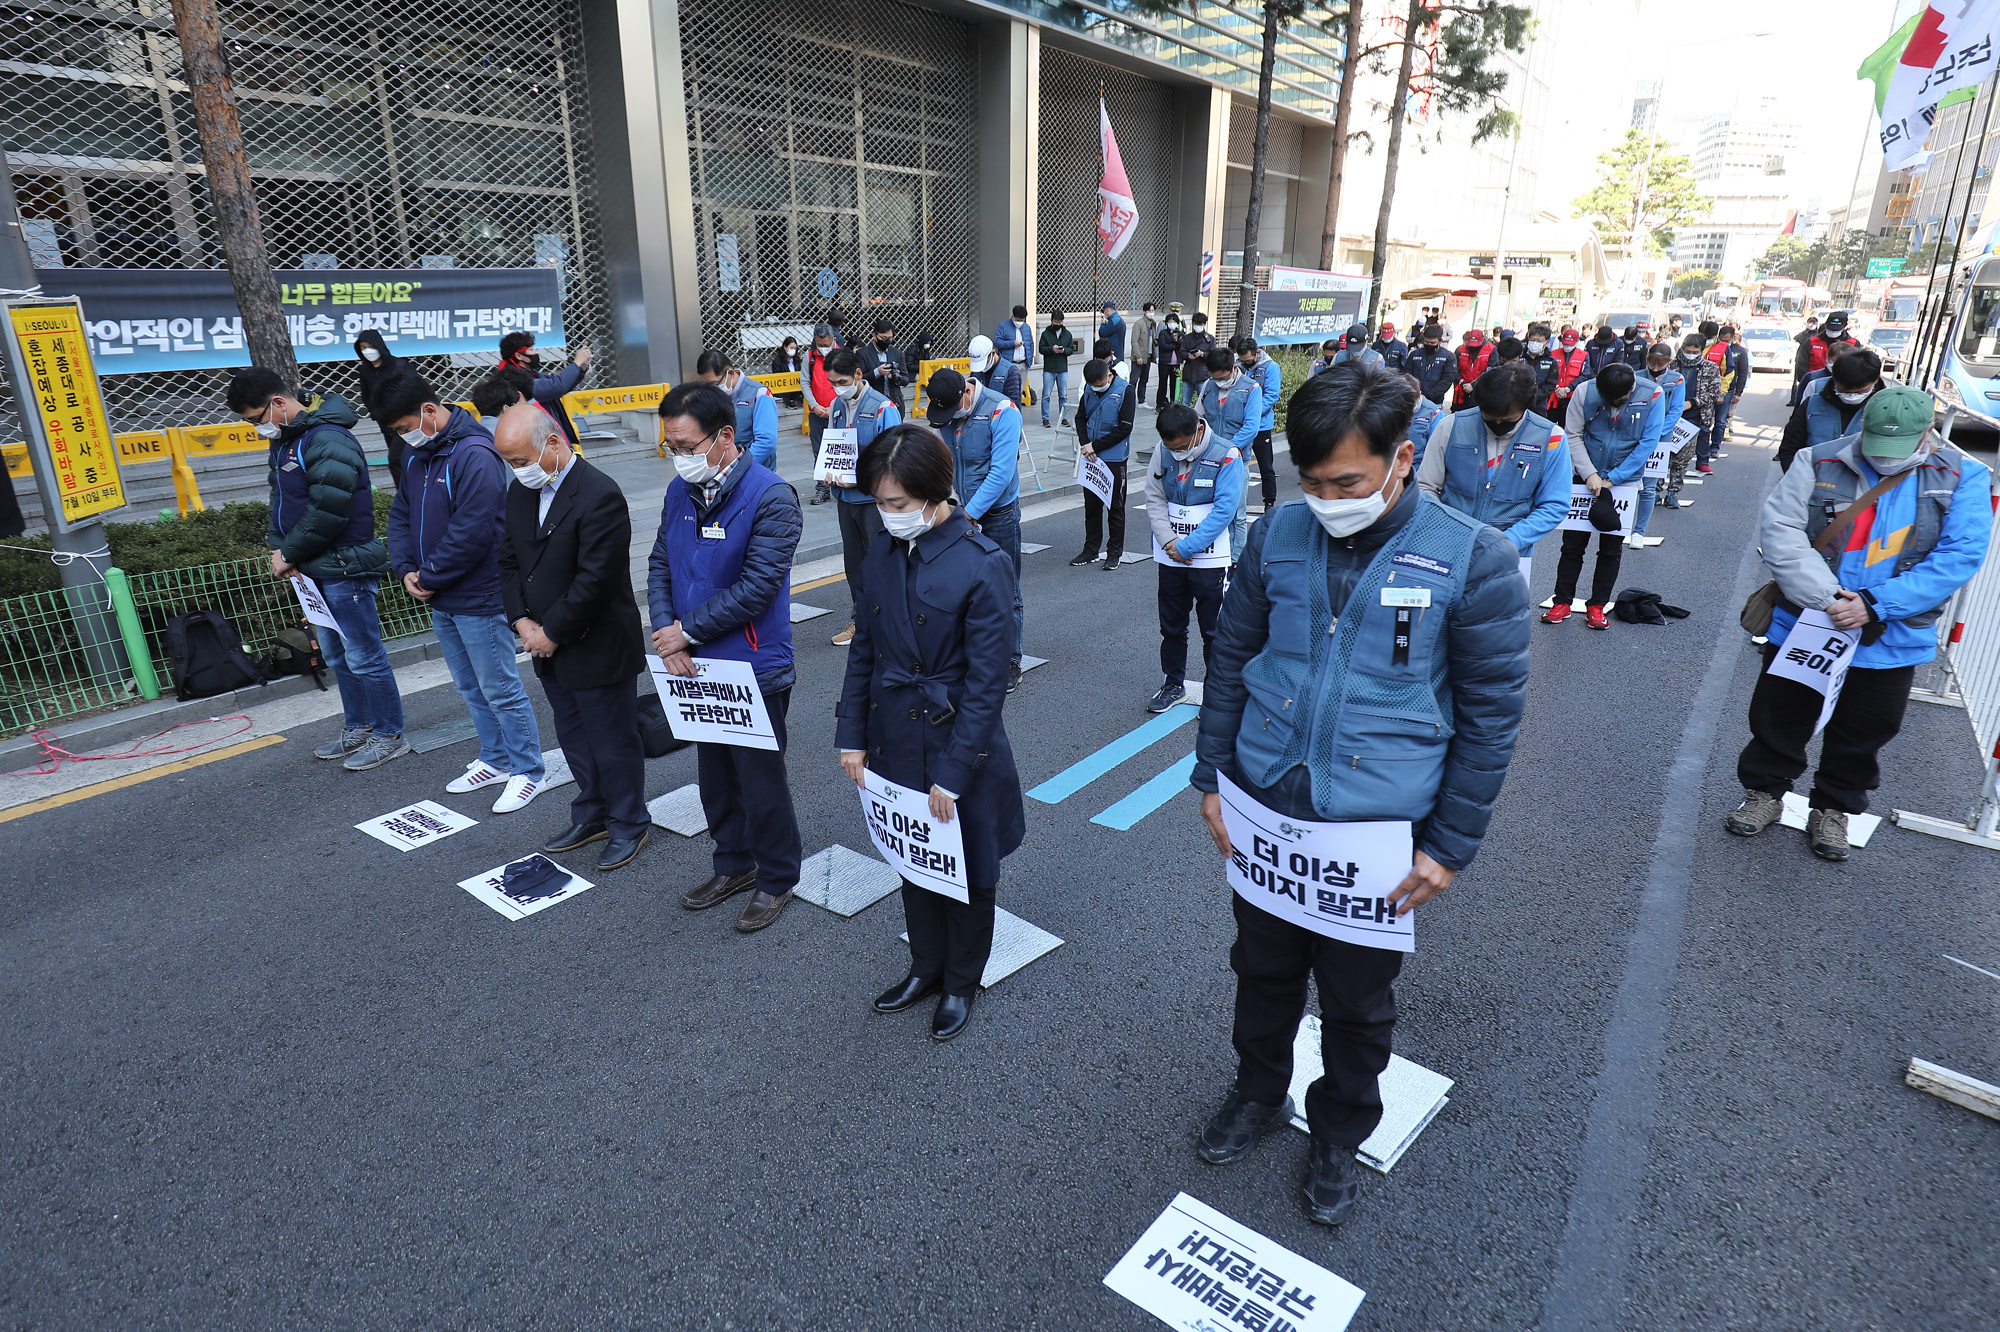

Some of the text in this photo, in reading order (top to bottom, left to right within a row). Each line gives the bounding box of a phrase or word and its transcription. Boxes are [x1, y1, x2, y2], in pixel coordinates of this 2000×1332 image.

[281, 283, 326, 306] 너무
[1305, 297, 1317, 312] 너무
[343, 309, 450, 346] 한진택배
[453, 306, 553, 338] 규탄한다!
[1260, 316, 1292, 337] 살인적인
[1288, 315, 1320, 335] 심야근무
[27, 339, 58, 412] 혼잡예상
[52, 337, 80, 408] 세종대로
[638, 391, 659, 402] LINE
[120, 440, 161, 456] LINE
[228, 433, 241, 444] 이
[49, 420, 77, 489] 우회바람
[63, 486, 119, 509] 7월 10일 부터
[1822, 636, 1849, 658] 더
[666, 679, 753, 705] 재벌택배사
[678, 702, 754, 728] 규탄한다!
[380, 817, 431, 841] 규탄한다!
[399, 809, 454, 835] 재벌택배사
[871, 799, 931, 844] 더 이상
[908, 842, 957, 878] 말라!
[1253, 833, 1359, 888] 더 이상
[1230, 843, 1397, 925] 죽이지 말라!
[1177, 1229, 1318, 1321] 규탄한다!
